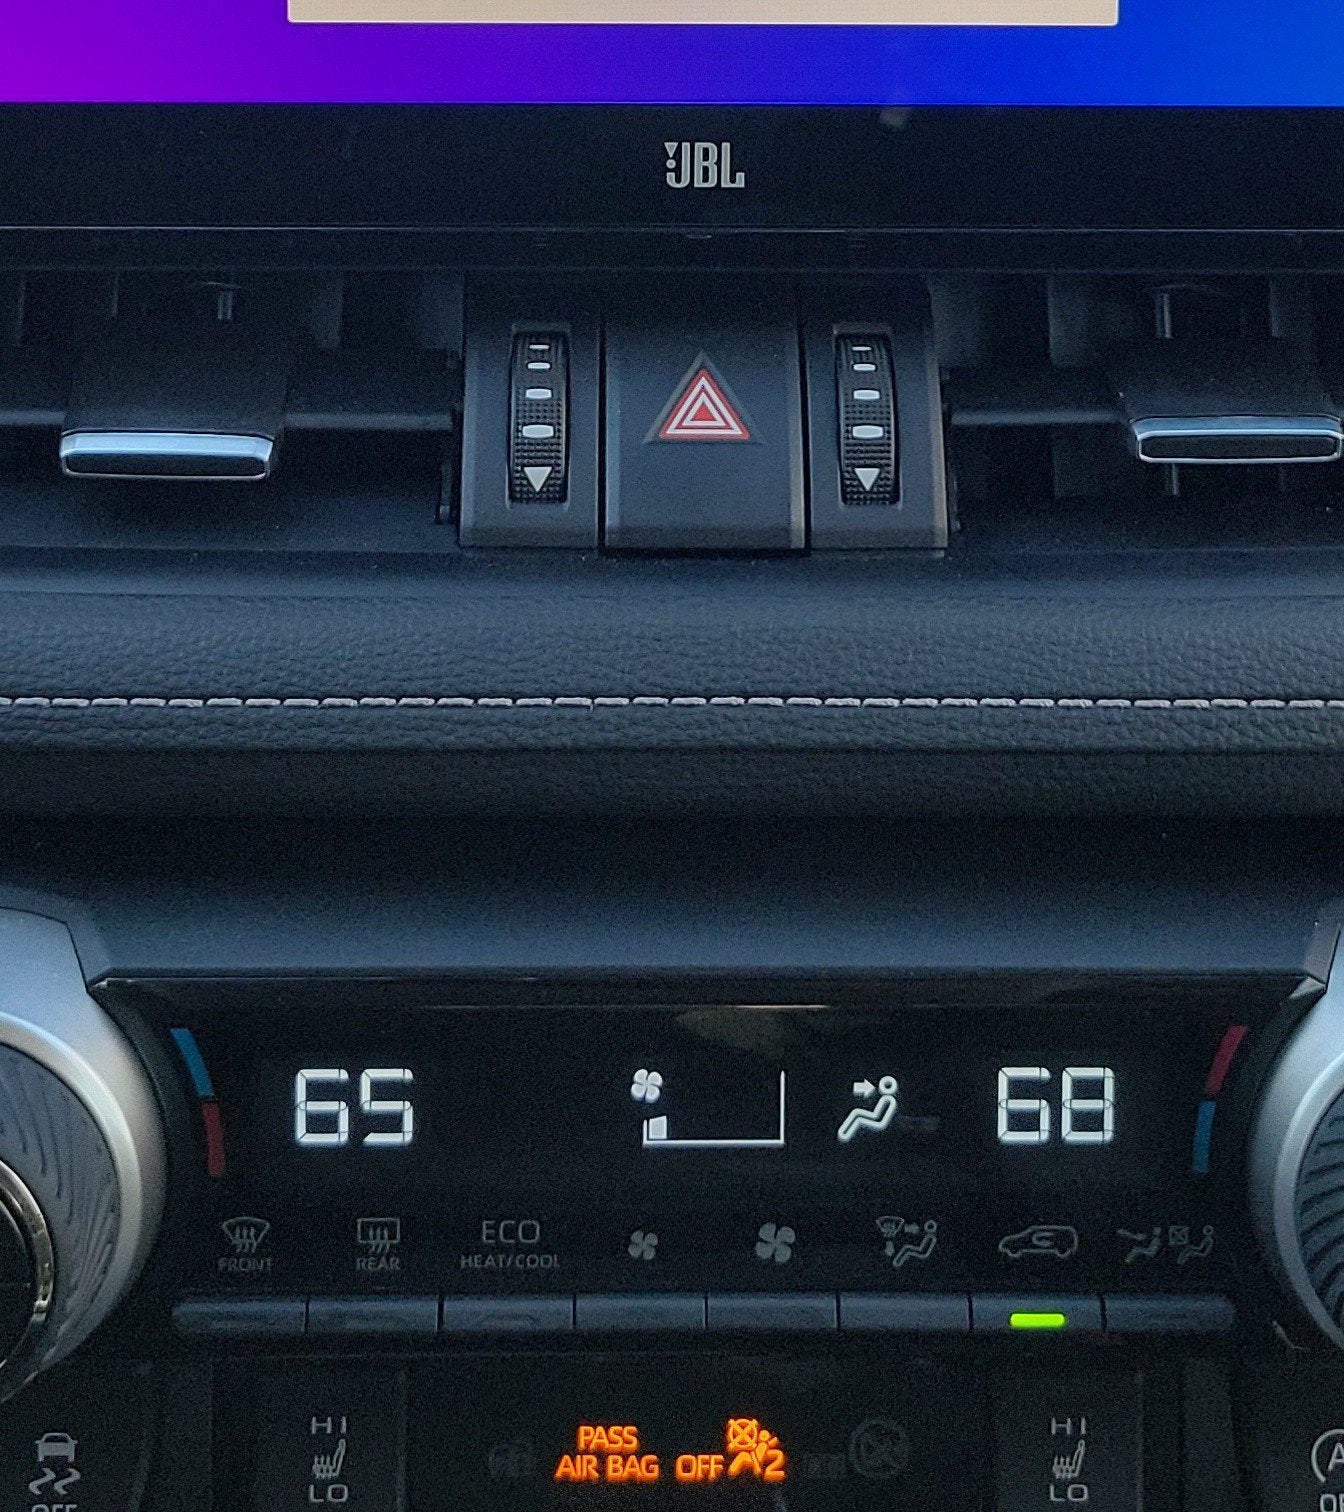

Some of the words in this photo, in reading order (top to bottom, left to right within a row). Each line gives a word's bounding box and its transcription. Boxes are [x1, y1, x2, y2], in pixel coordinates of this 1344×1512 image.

[662, 141, 746, 189] JBL
[294, 1067, 415, 1146] 65
[996, 1066, 1115, 1144] 68
[481, 1219, 542, 1245] ECO
[218, 1256, 273, 1273] FRONT
[356, 1256, 401, 1272] REAR
[460, 1253, 562, 1271] HEAT/COOL
[310, 1416, 348, 1435] HI
[1050, 1417, 1088, 1436] HI
[577, 1424, 639, 1451] PASS
[555, 1453, 599, 1481] AIR
[606, 1453, 660, 1481] BAG
[675, 1453, 724, 1480] OFF
[308, 1484, 350, 1504] LO
[1049, 1483, 1090, 1503] LO
